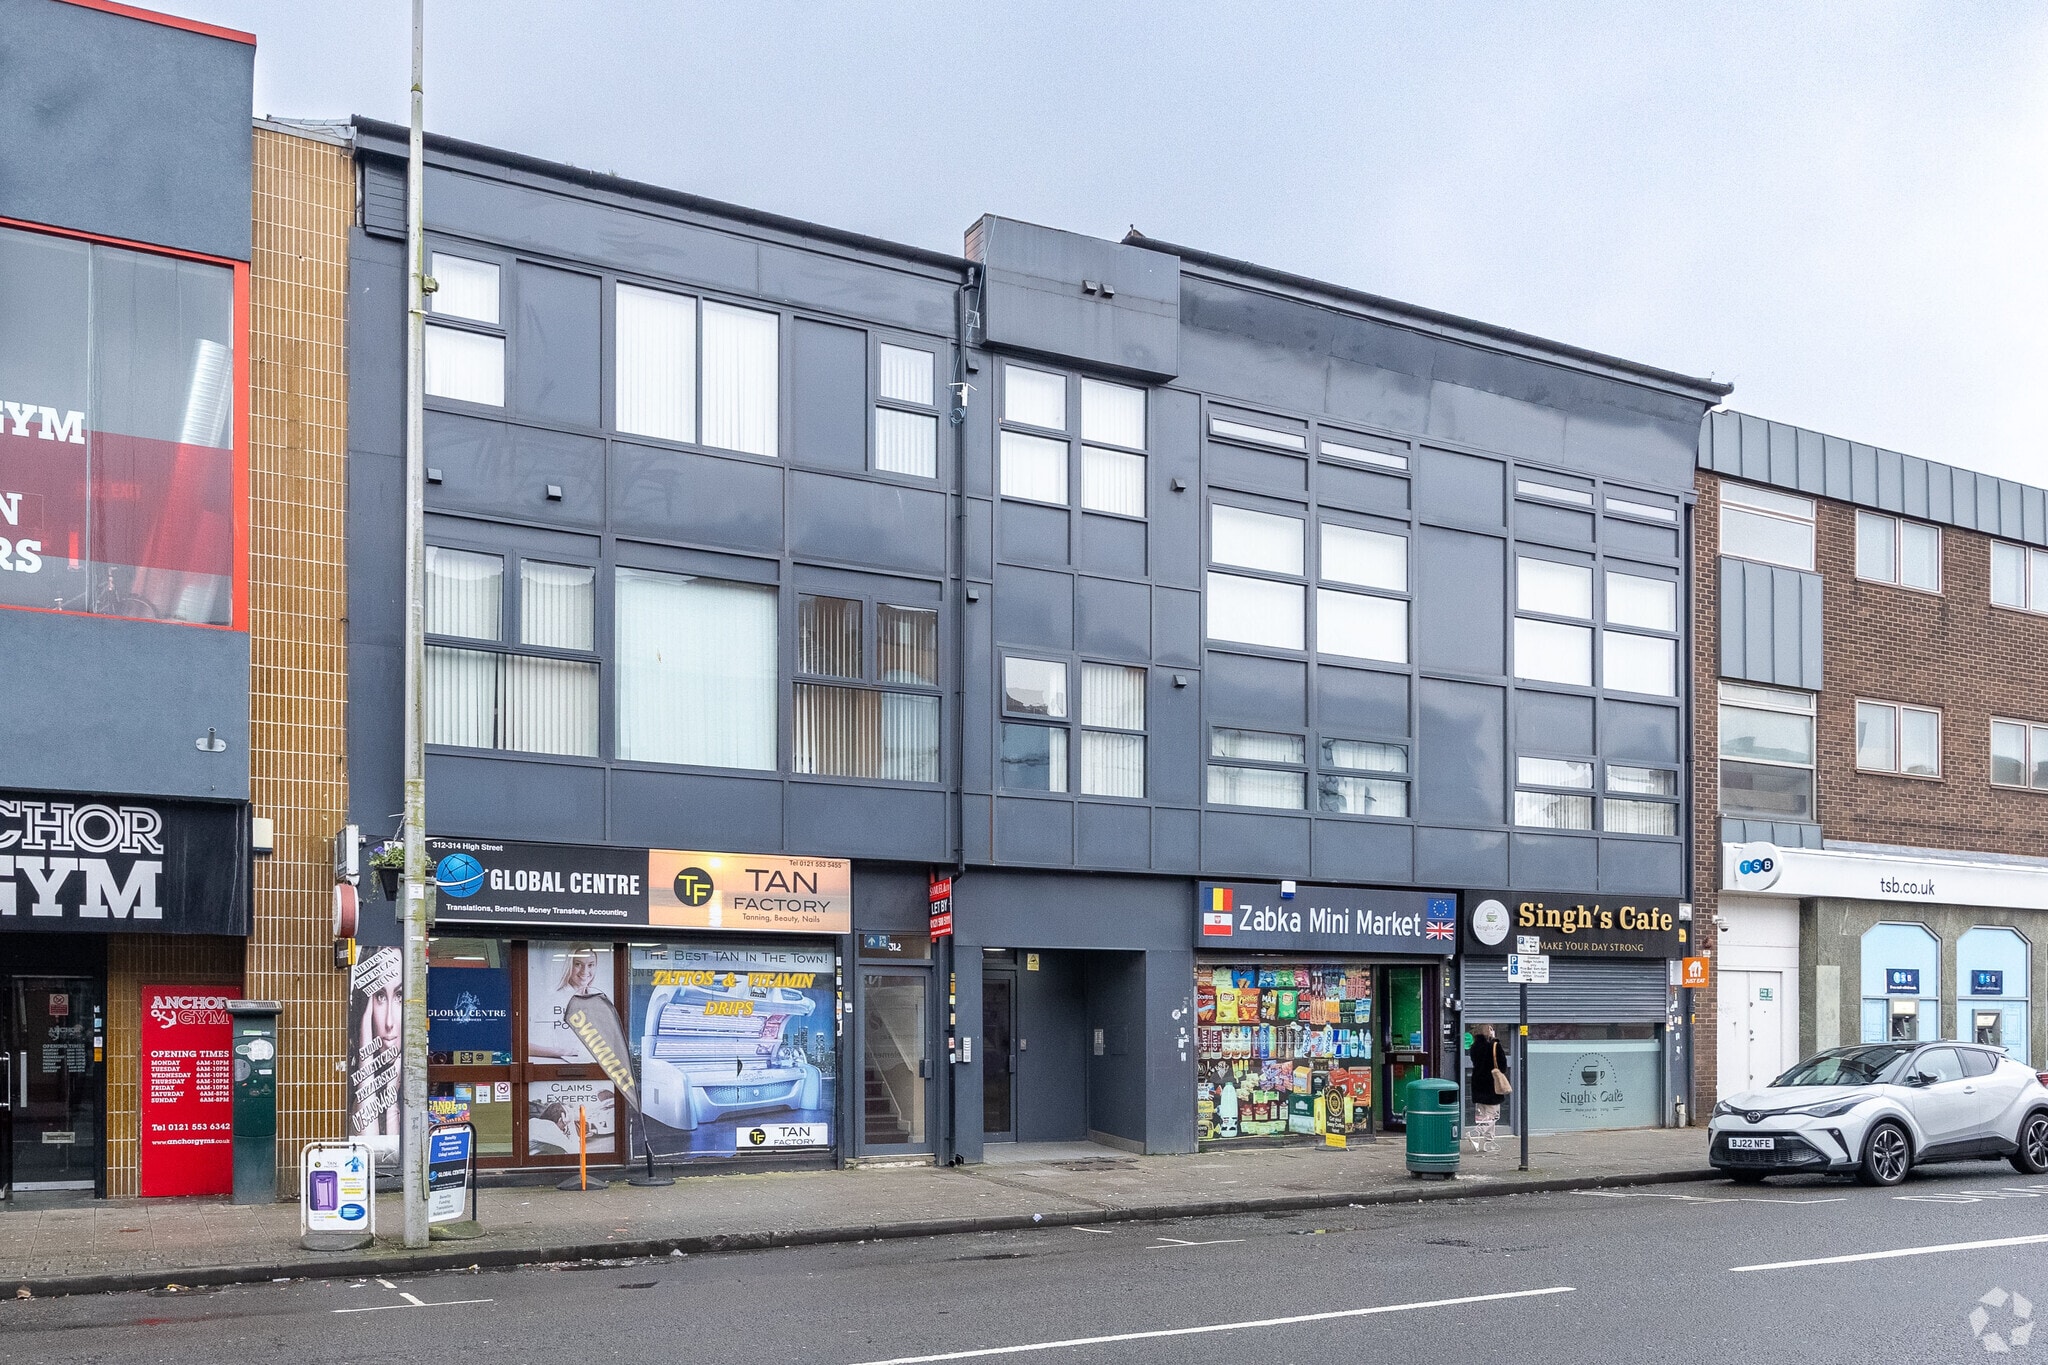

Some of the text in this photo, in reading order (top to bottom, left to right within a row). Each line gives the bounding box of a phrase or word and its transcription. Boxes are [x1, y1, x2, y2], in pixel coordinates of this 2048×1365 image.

[0, 401, 85, 445] YM
[432, 841, 504, 852] 312-314 High Street
[789, 859, 799, 867] Tel
[799, 860, 813, 868] 0121
[1742, 857, 1774, 872] TSB
[0, 854, 163, 920] YM
[490, 868, 640, 896] GLOBAL CENTRE
[745, 868, 818, 895] TAN
[1880, 876, 1936, 896] tsb.co.uk
[446, 903, 628, 917] Translations, Benefits, Money Transfers, Accounting
[734, 897, 831, 913] FACTORY
[931, 898, 948, 915] LET BY
[742, 912, 820, 923] Tanning, Beauty, Nails
[1239, 904, 1421, 937] Zabka Mini Market
[1519, 902, 1673, 934] Singh's Cafe
[1539, 942, 1563, 950] MAKE
[1564, 941, 1589, 951] YOUR
[1592, 943, 1609, 951] DAY
[1610, 943, 1644, 952] STRONG
[674, 951, 708, 961] BEST
[715, 951, 740, 962] TAN
[745, 953, 758, 962] IN
[762, 953, 787, 963] THE
[793, 953, 829, 964] TOWN!
[652, 970, 716, 986] TATTOS
[722, 972, 737, 987] &
[748, 972, 816, 988] VITAMIN
[150, 996, 229, 1009] ANCHOR
[703, 1001, 754, 1015] DRIPS
[178, 1010, 229, 1025] GYM
[469, 1009, 507, 1017] CENTRE
[150, 1050, 230, 1058] OPENING TIMES
[551, 1083, 593, 1092] CLAIMS
[547, 1094, 598, 1103] EXPERTS
[1560, 1090, 1597, 1105] Singh's
[779, 1127, 810, 1137] TAN
[774, 1138, 816, 1146] FACTORY
[1732, 1139, 1771, 1148] BJ22 NFE
